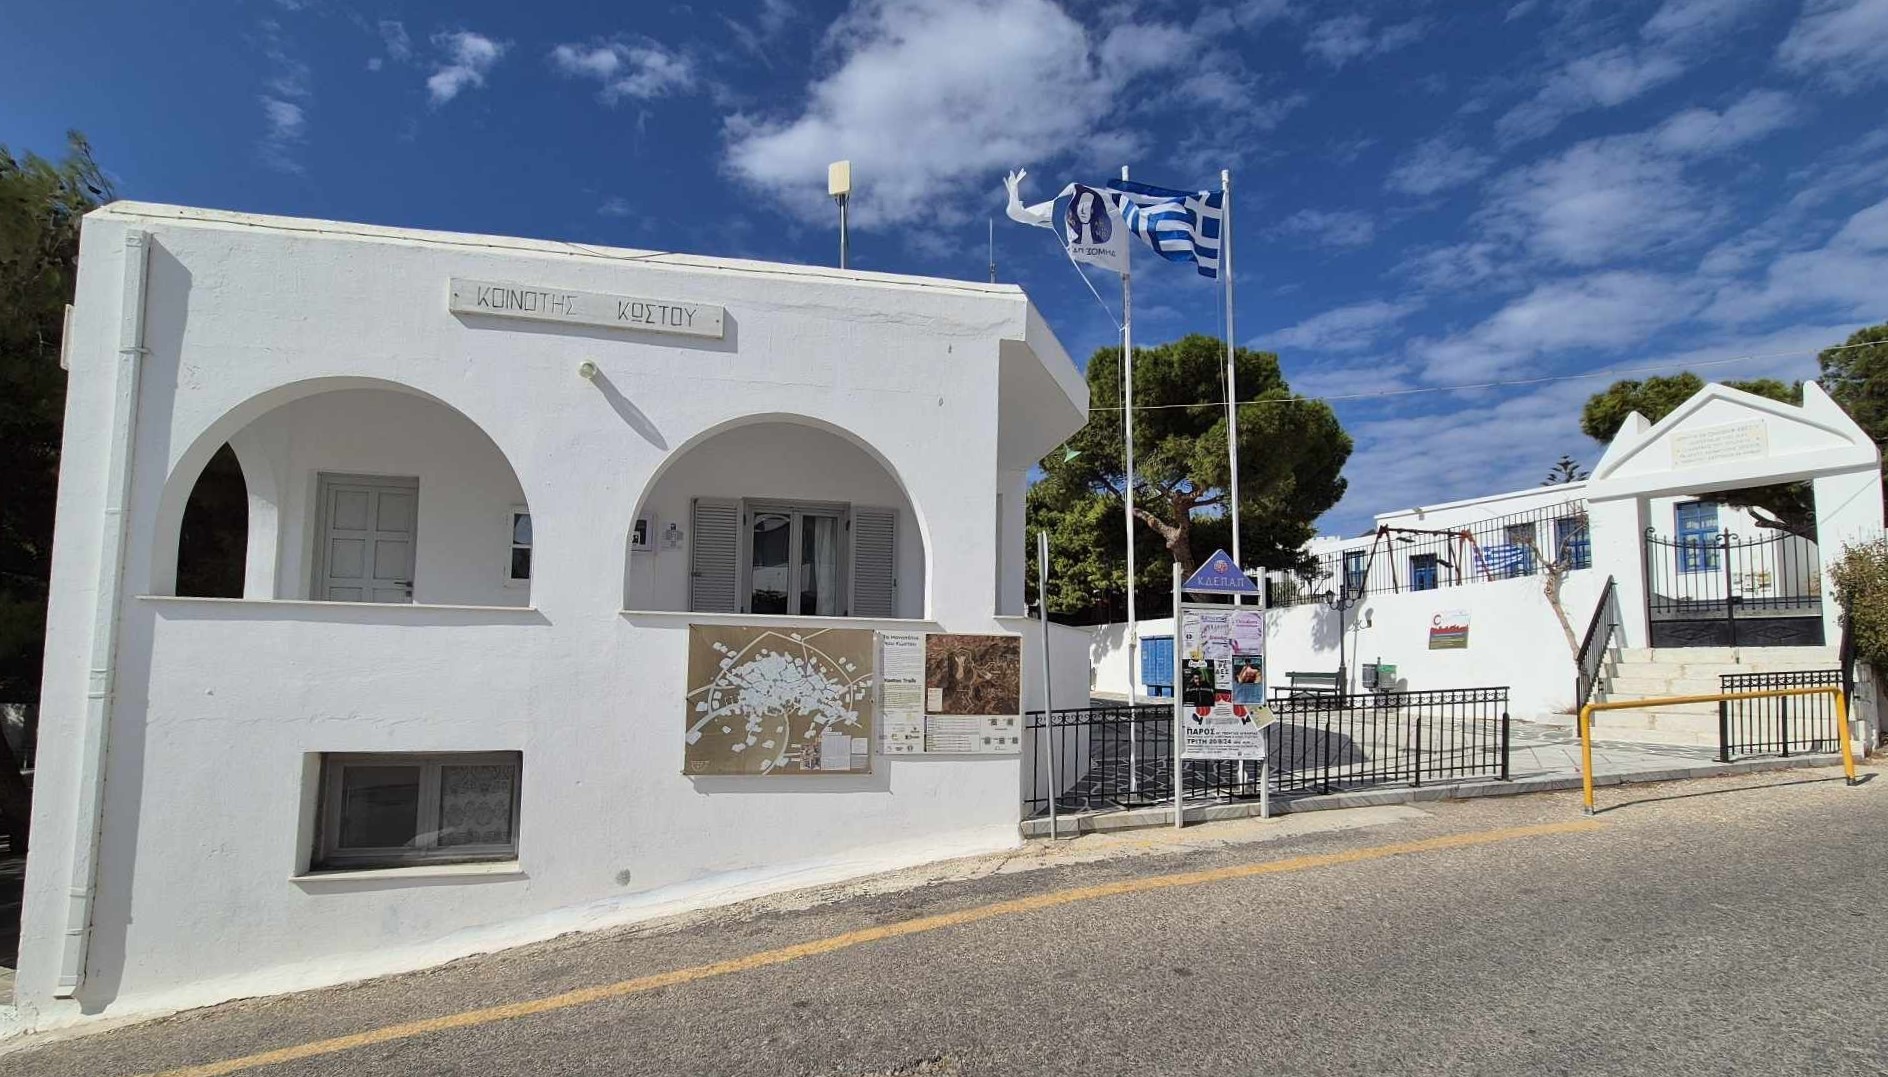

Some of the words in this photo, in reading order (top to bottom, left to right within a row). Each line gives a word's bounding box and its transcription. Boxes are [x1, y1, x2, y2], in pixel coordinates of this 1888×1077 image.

[477, 285, 579, 316] ΚΟΙΝΟΤΗΣ
[618, 300, 697, 328] ΚΩΣΤΟΥ
[1186, 728, 1215, 736] ΠΑΡΟΣ
